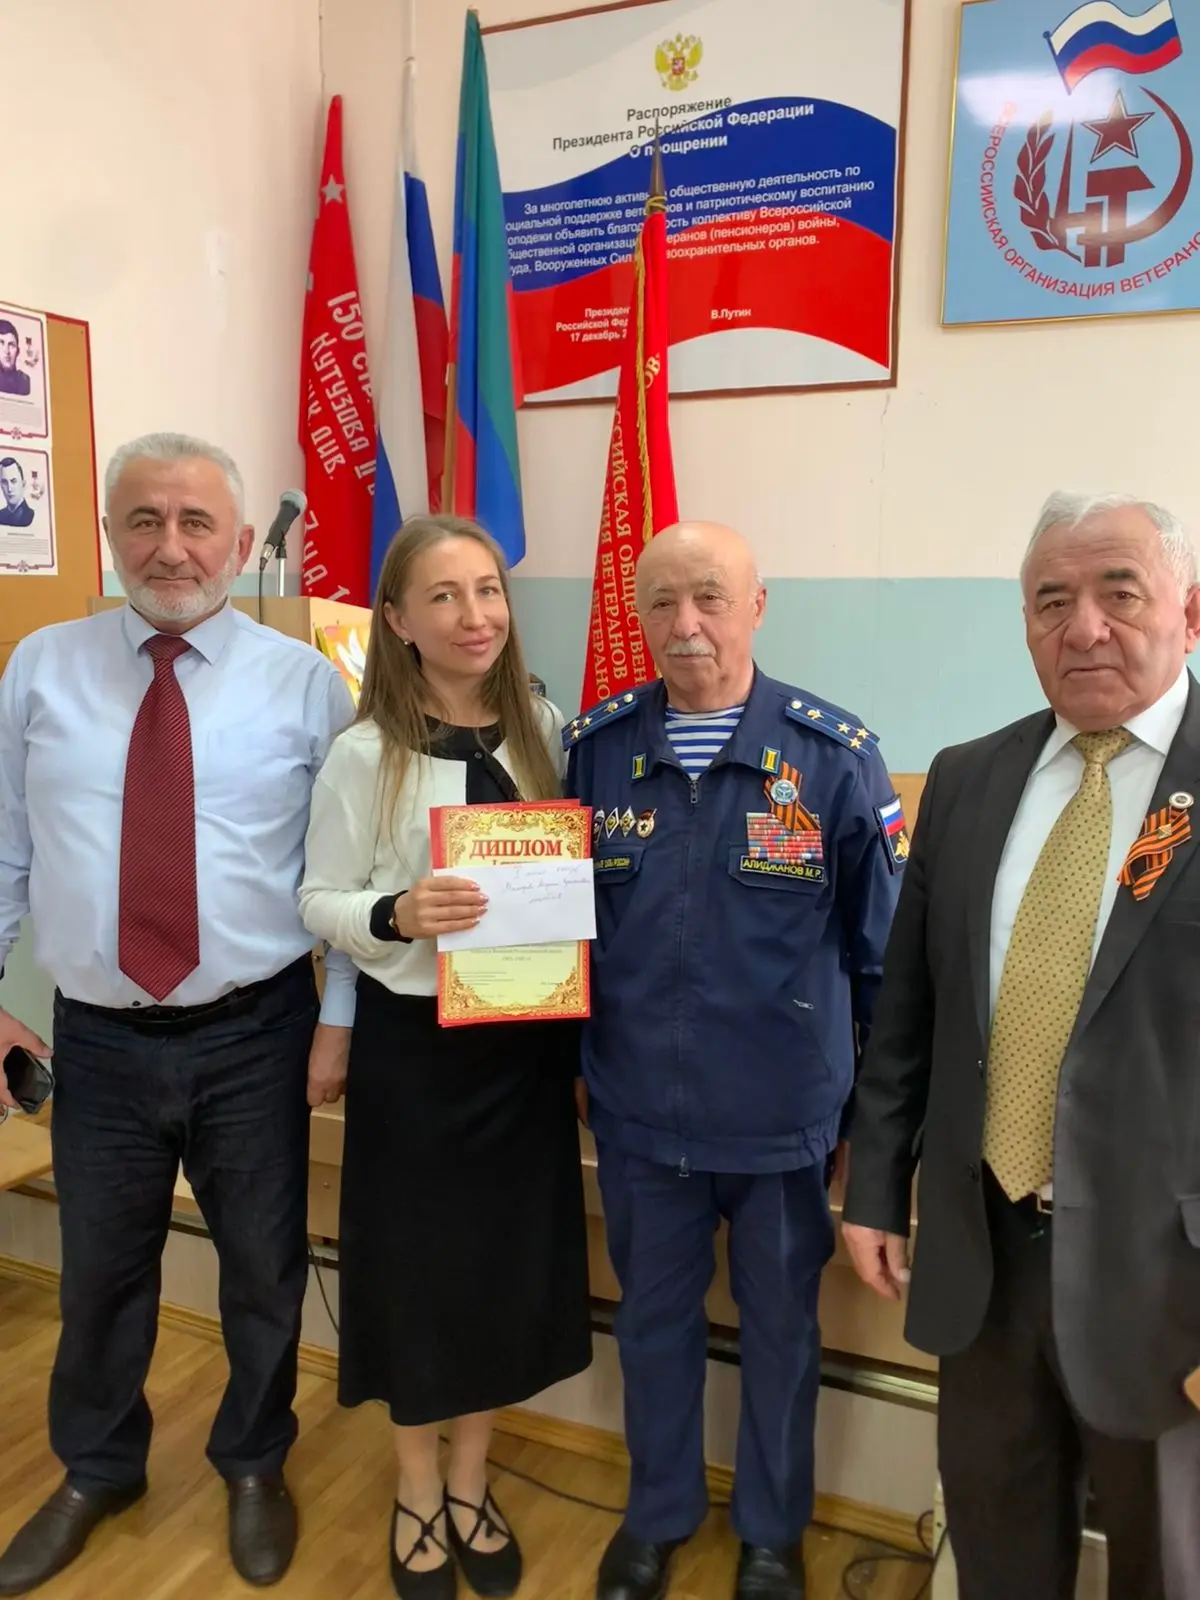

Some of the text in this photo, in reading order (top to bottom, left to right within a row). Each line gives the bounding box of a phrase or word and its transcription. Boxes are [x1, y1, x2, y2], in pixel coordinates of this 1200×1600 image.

[552, 103, 815, 151] Президента Российской Федерации
[627, 96, 732, 122] Распоряжение
[628, 134, 728, 158] О пощрении
[505, 211, 562, 232] оциальной
[564, 208, 622, 226] поддержке
[686, 200, 693, 211] и
[696, 188, 797, 210] патриотическому
[800, 179, 875, 199] воспитанию
[524, 203, 538, 215] За
[540, 194, 613, 213] многолетнюю
[669, 177, 756, 199] общественную
[758, 168, 842, 188] деятельность
[845, 165, 861, 178] по
[507, 231, 552, 247] олодежи
[554, 225, 605, 241] объявить
[691, 209, 760, 226] коллективу
[759, 197, 852, 219] Всероссийской
[508, 243, 576, 261] бщественной
[666, 229, 707, 245] еранов
[710, 220, 795, 240] (пенсионеров)
[798, 216, 840, 231] войны,
[510, 264, 532, 277] уда,
[535, 255, 607, 273] Вооруженных
[610, 251, 632, 264] Сил
[768, 235, 820, 252] органов.
[1003, 247, 1115, 301] ОРГАНИЗАЦИЯ
[1119, 230, 1200, 294] ВЕТЕРАНО
[327, 290, 365, 341] 150
[556, 318, 609, 333] Российской
[570, 332, 580, 343] 17
[584, 306, 752, 321] Президен В.Путин
[601, 550, 629, 680] ВЕТЕРАНОВ
[618, 543, 647, 687] ОБЩЕСТВЕН
[591, 587, 611, 702] ВЕТЕРАНО
[469, 838, 563, 860] ДИПЛОМ
